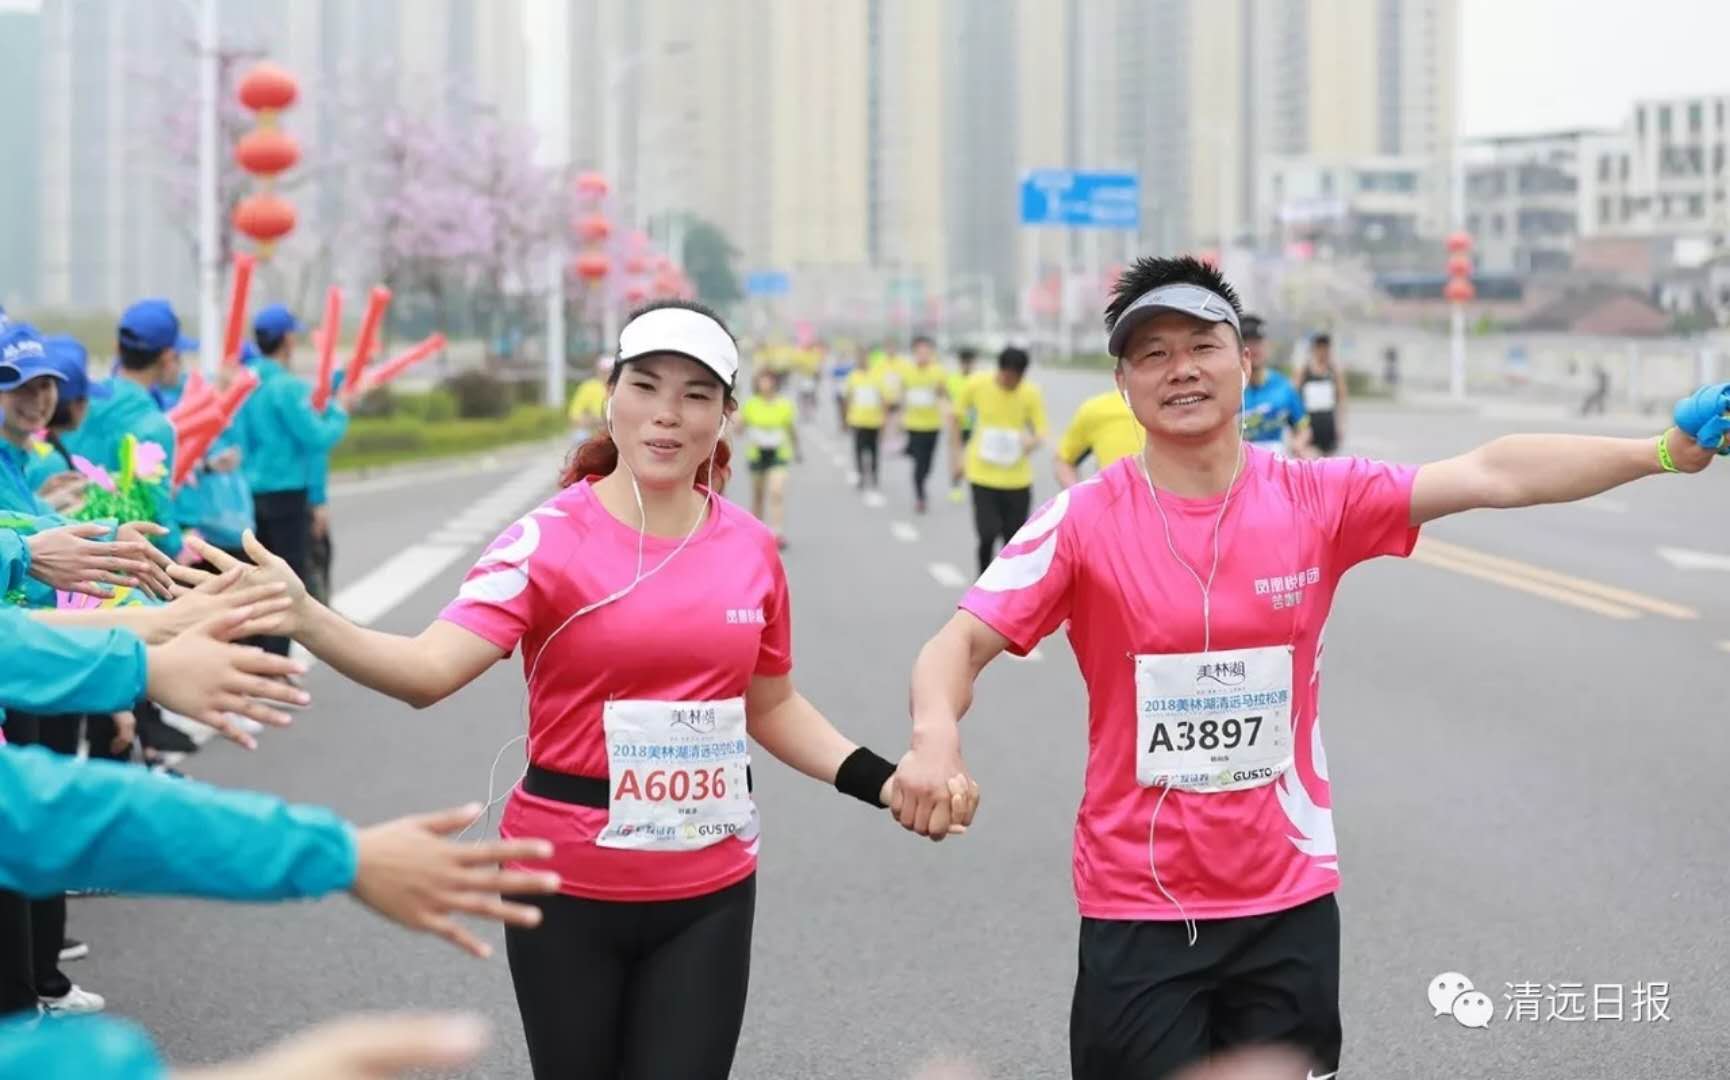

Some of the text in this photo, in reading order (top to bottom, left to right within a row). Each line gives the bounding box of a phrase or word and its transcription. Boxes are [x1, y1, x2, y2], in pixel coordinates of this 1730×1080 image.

[1144, 689, 1289, 712] 2018美林湖清远马拉松赛
[1148, 716, 1263, 753] A3897
[613, 740, 746, 760] 2018美林湖清远马拉松赛
[614, 768, 727, 802] A6036
[1233, 767, 1273, 782] GUSTO
[698, 823, 736, 836] GUSTO
